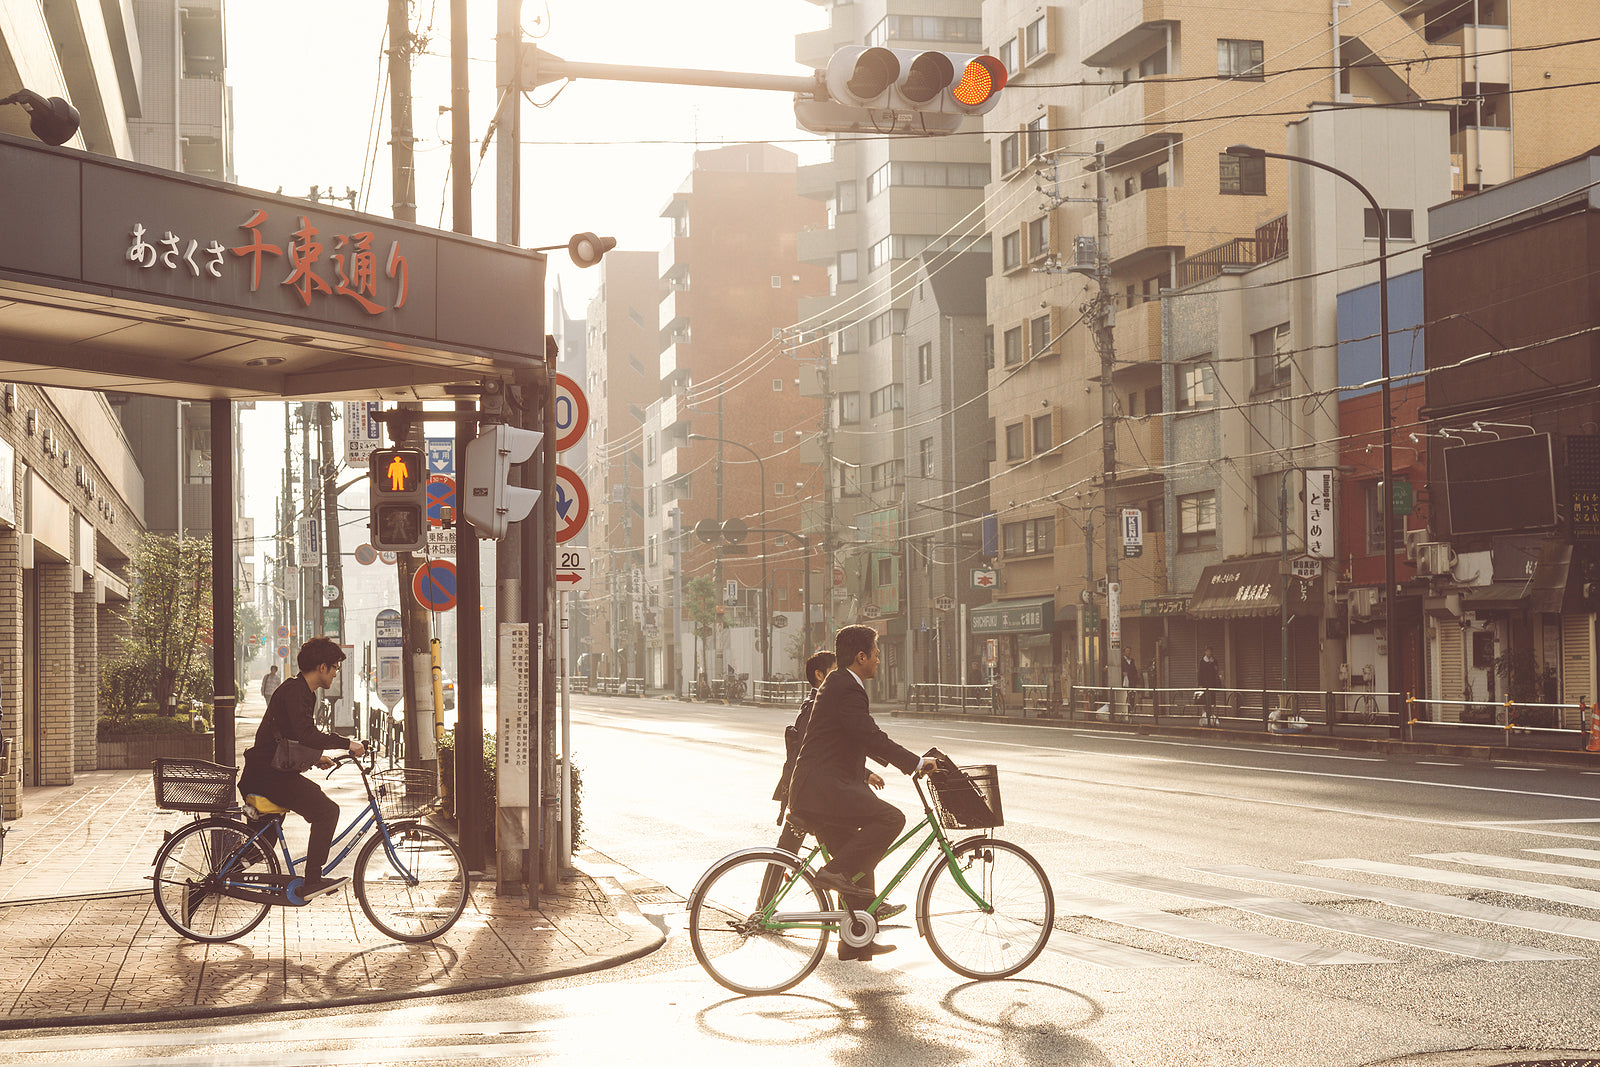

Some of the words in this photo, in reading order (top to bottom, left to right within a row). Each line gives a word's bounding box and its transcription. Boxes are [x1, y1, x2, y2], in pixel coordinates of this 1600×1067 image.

[126, 222, 225, 279] あさくさ
[432, 451, 449, 460] 専用
[1128, 517, 1137, 538] KEN
[1310, 493, 1323, 553] ときめき
[562, 553, 579, 567] 20
[977, 576, 992, 586] 本
[972, 615, 997, 628] SHICHIFUKU
